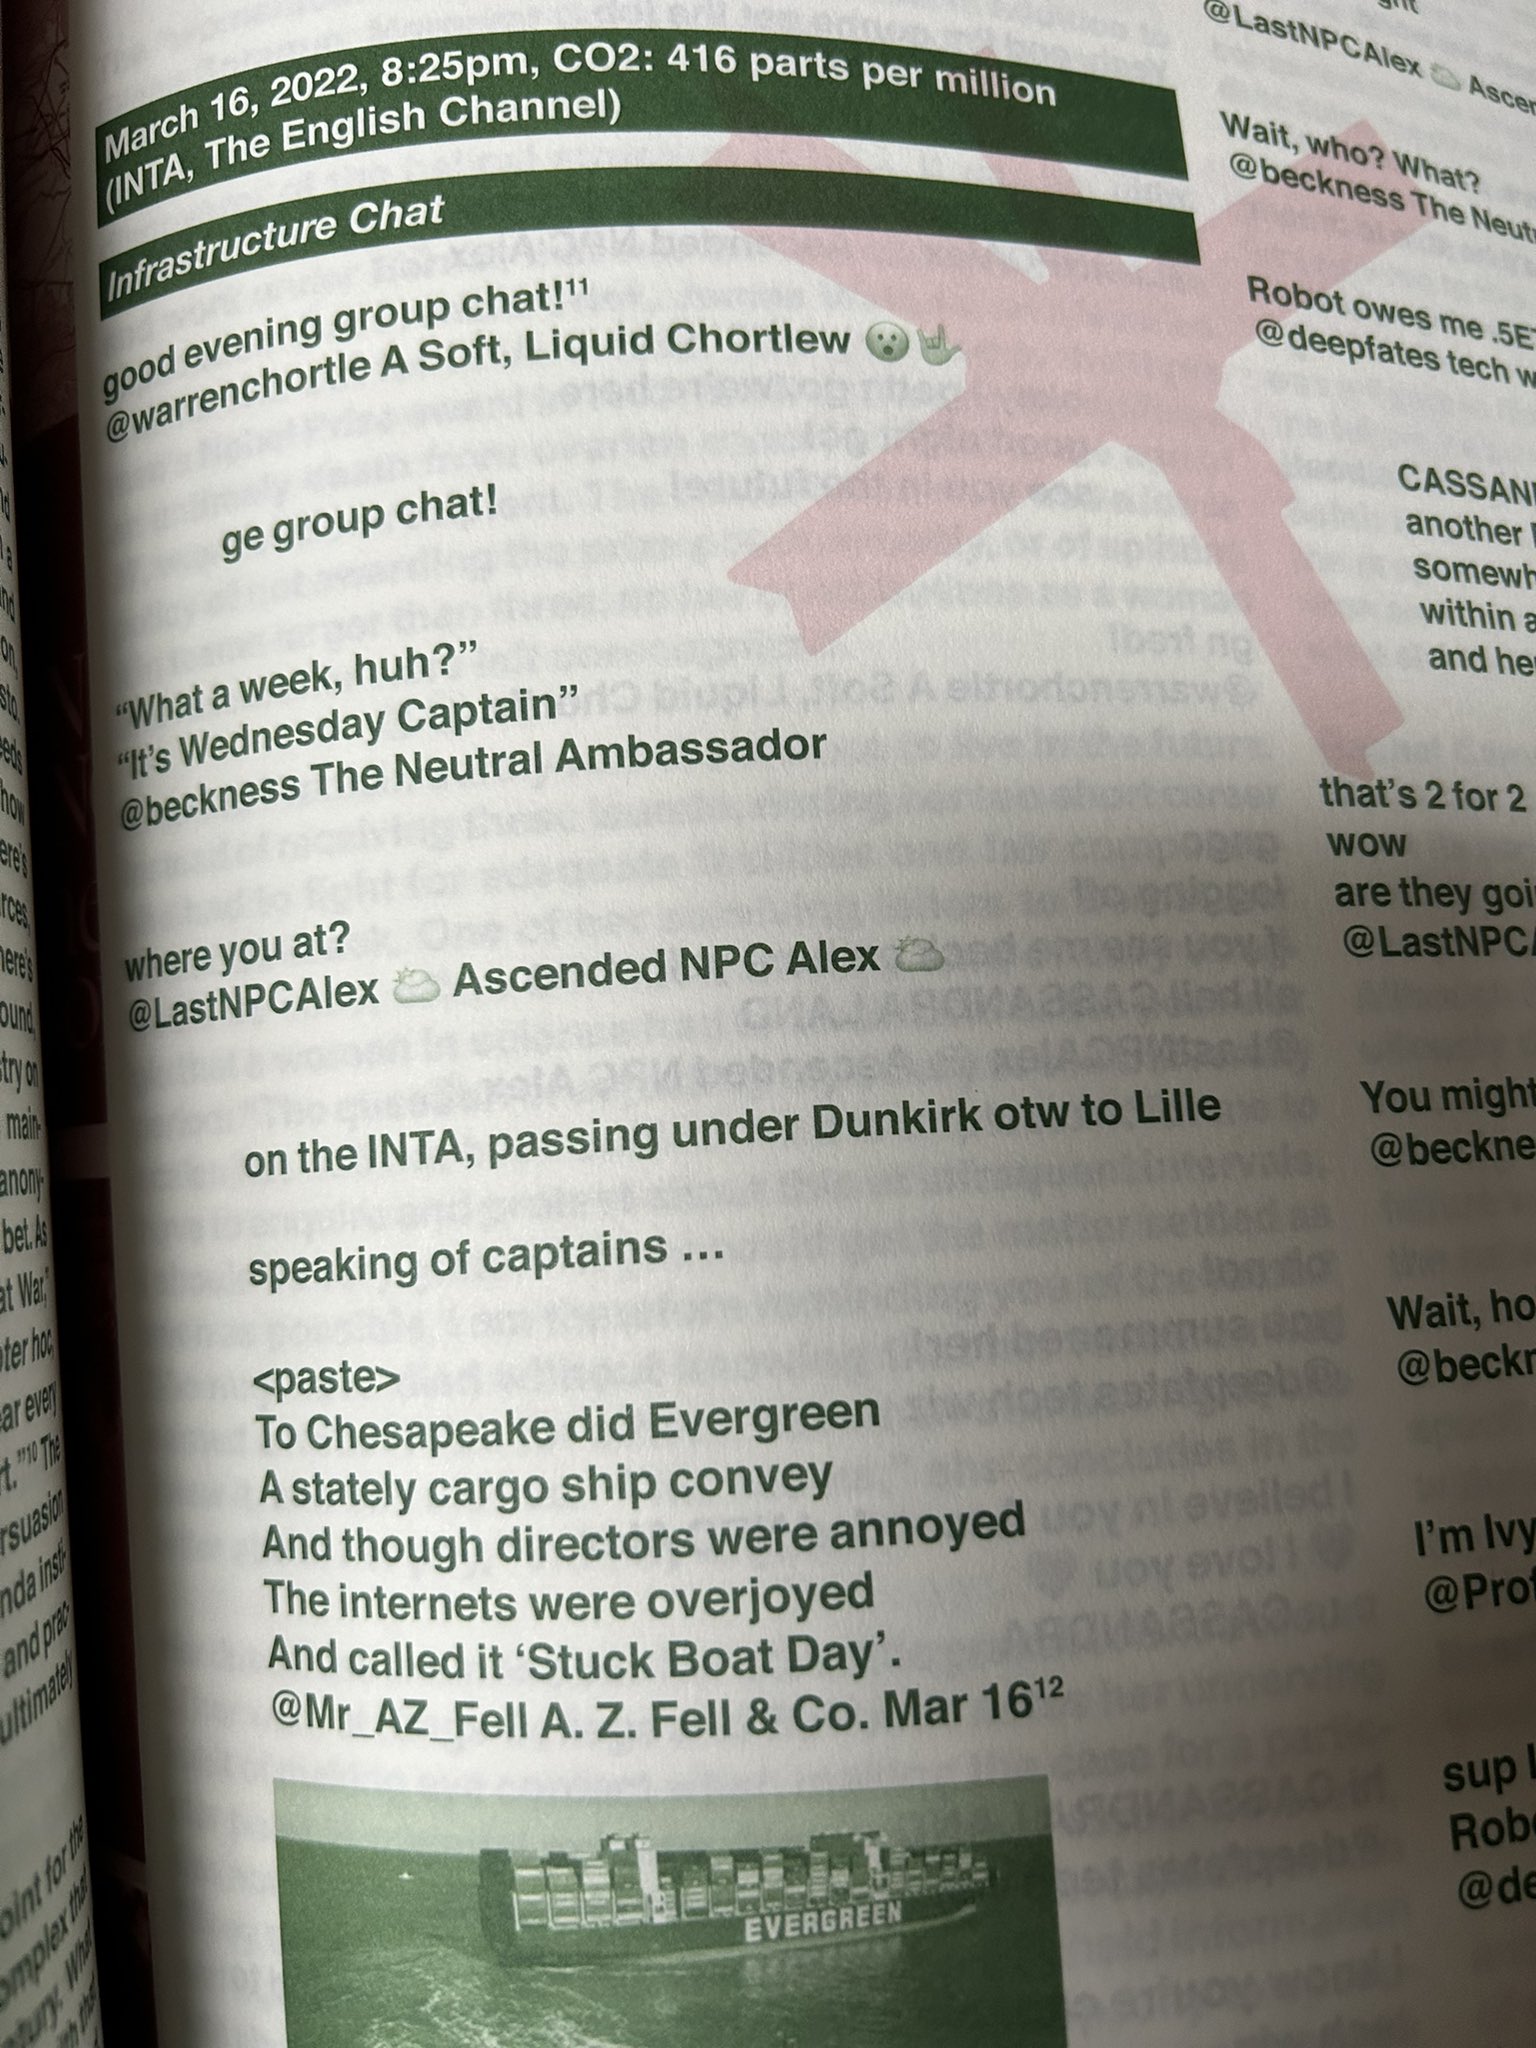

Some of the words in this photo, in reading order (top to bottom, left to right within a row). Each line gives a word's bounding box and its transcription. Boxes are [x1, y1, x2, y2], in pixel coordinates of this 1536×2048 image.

[1203, 0, 1423, 79] @LastNPCAlex
[106, 103, 199, 161] March
[210, 86, 259, 121] 16,
[270, 63, 368, 107] 2022,
[381, 50, 539, 87] 8:25pm,
[553, 41, 653, 73] CO2:
[667, 43, 737, 74] 416
[750, 51, 849, 82] parts
[862, 61, 923, 91] per
[935, 68, 1056, 107] million
[106, 152, 194, 215] (INTA,
[204, 133, 270, 170] The
[282, 101, 426, 152] English
[439, 87, 621, 127] Channel)
[1219, 110, 1299, 155] Wait,
[1305, 135, 1385, 170] who?
[1391, 150, 1480, 195] What?
[1230, 153, 1405, 211] @beckness
[1409, 189, 1466, 226] The
[108, 216, 337, 302] Infrastructure
[350, 194, 446, 234] Chat
[1246, 275, 1346, 316] Robot
[1352, 298, 1432, 331] owes
[1439, 314, 1484, 340] me
[1492, 321, 1536, 351] .5E
[103, 345, 176, 404] good
[184, 315, 322, 369] evening
[333, 297, 451, 343] group
[1255, 317, 1441, 372] @deepfates
[1446, 350, 1510, 384] tech
[106, 352, 371, 443] @warrenchortle
[380, 344, 409, 377] A
[419, 334, 512, 372] Soft,
[525, 324, 654, 366] Liquid
[667, 322, 851, 354] Chortlew
[1397, 463, 1536, 507] CASSAN
[222, 525, 264, 565] ge
[273, 504, 385, 554] group
[396, 482, 497, 525] chat!
[1405, 513, 1523, 547] another
[1419, 597, 1516, 632] within
[212, 684, 230, 710] a
[238, 659, 342, 704] week,
[1428, 644, 1488, 674] and
[178, 708, 386, 769] Wednesday
[397, 684, 578, 737] Captain”
[120, 775, 300, 831] @beckness
[310, 760, 384, 796] The
[395, 740, 543, 787] Neutral
[555, 727, 828, 773] Ambassador
[1319, 776, 1418, 810] that’s
[1425, 779, 1446, 810] 2
[1451, 780, 1499, 812] for
[1506, 783, 1527, 813] 2
[1326, 832, 1407, 858] wow
[1335, 882, 1392, 908] are
[1398, 875, 1472, 916] they
[1482, 877, 1536, 917] goi
[124, 943, 211, 983] where
[218, 935, 282, 978] you
[293, 919, 350, 959] at?
[1343, 924, 1536, 958] @LastNPC
[128, 976, 379, 1032] @LastNPCAlex
[453, 948, 667, 997] Ascended
[680, 942, 775, 982] NPC
[786, 939, 881, 976] Alex
[1359, 1080, 1432, 1114] You
[1441, 1076, 1536, 1119] might
[244, 1149, 288, 1178] on
[297, 1138, 358, 1174] the
[368, 1128, 475, 1169] INTA,
[489, 1117, 659, 1170] passing
[673, 1108, 800, 1148] under
[813, 1097, 984, 1140] Dunkirk
[994, 1096, 1070, 1131] otw
[1080, 1093, 1123, 1127] to
[1134, 1087, 1222, 1124] Lille
[1371, 1129, 1536, 1168] @beckne
[249, 1245, 418, 1294] speaking
[430, 1238, 471, 1277] of
[482, 1229, 668, 1281] captains
[1386, 1291, 1482, 1332] Wait,
[1489, 1288, 1536, 1323] ho
[24, 1380, 57, 1424] every
[252, 1360, 401, 1404] <paste>
[40, 1433, 61, 1471] The
[255, 1414, 297, 1450] To
[306, 1409, 556, 1458] Chesapeake
[567, 1403, 635, 1444] did
[650, 1397, 881, 1444] Evergreen
[259, 1469, 285, 1504] A
[292, 1470, 417, 1516] stately
[429, 1475, 549, 1515] cargo
[562, 1463, 657, 1510] ship
[670, 1460, 833, 1502] convey
[262, 1524, 332, 1562] And
[341, 1526, 484, 1574] though
[496, 1525, 696, 1564] directors
[707, 1521, 818, 1556] were
[830, 1498, 1026, 1553] annoyed
[1414, 1519, 1475, 1557] I’m
[1484, 1513, 1536, 1556] Ivy
[263, 1578, 330, 1617] The
[339, 1582, 517, 1622] internets
[528, 1590, 636, 1621] were
[647, 1569, 875, 1625] overjoyed
[3, 1620, 40, 1680] and
[267, 1634, 337, 1674] And
[348, 1641, 465, 1680] called
[478, 1642, 504, 1680] it
[668, 1638, 774, 1678] Boat
[271, 1689, 528, 1743] @Mr_AZ_Fell
[540, 1702, 583, 1739] A.
[596, 1701, 637, 1739] Z.
[651, 1698, 731, 1738] Fell
[746, 1697, 779, 1736] &
[793, 1694, 869, 1734] Co.
[884, 1688, 969, 1728] Mar
[1443, 1755, 1517, 1796] sup
[1450, 1805, 1536, 1852] Rob
[745, 1900, 902, 1943] EVERGREEN
